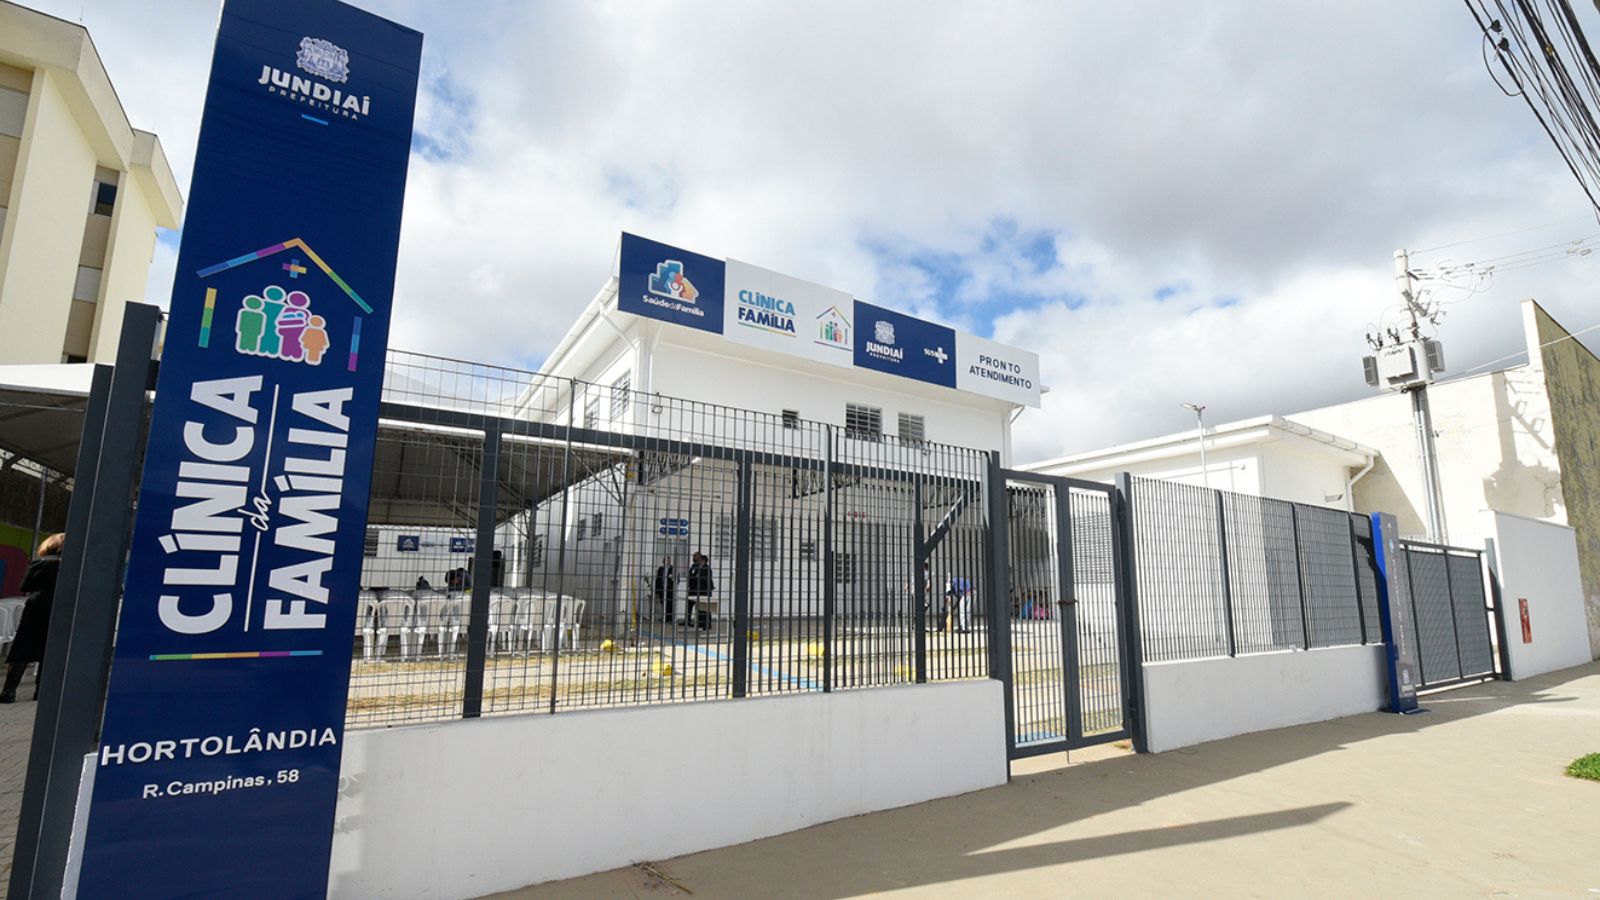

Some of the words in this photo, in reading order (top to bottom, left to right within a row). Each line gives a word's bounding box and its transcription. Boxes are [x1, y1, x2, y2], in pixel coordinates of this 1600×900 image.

[258, 65, 370, 115] JUNDIAÍ
[269, 86, 358, 120] PREFEITURA
[738, 289, 796, 316] CLÍNICA
[738, 306, 796, 333] FAMÍLIA
[866, 341, 904, 359] JUNDIAÍ
[979, 354, 1021, 374] PRONTO
[969, 365, 1032, 390] ATENDIMENTO
[158, 375, 263, 634] CLÍNICA
[237, 491, 272, 531] da
[263, 387, 354, 630] FAMÍLIA
[101, 727, 337, 766] HORTOLÂNDIA
[142, 783, 164, 799] R.
[166, 774, 272, 796] Campinas,
[277, 769, 300, 784] 58
